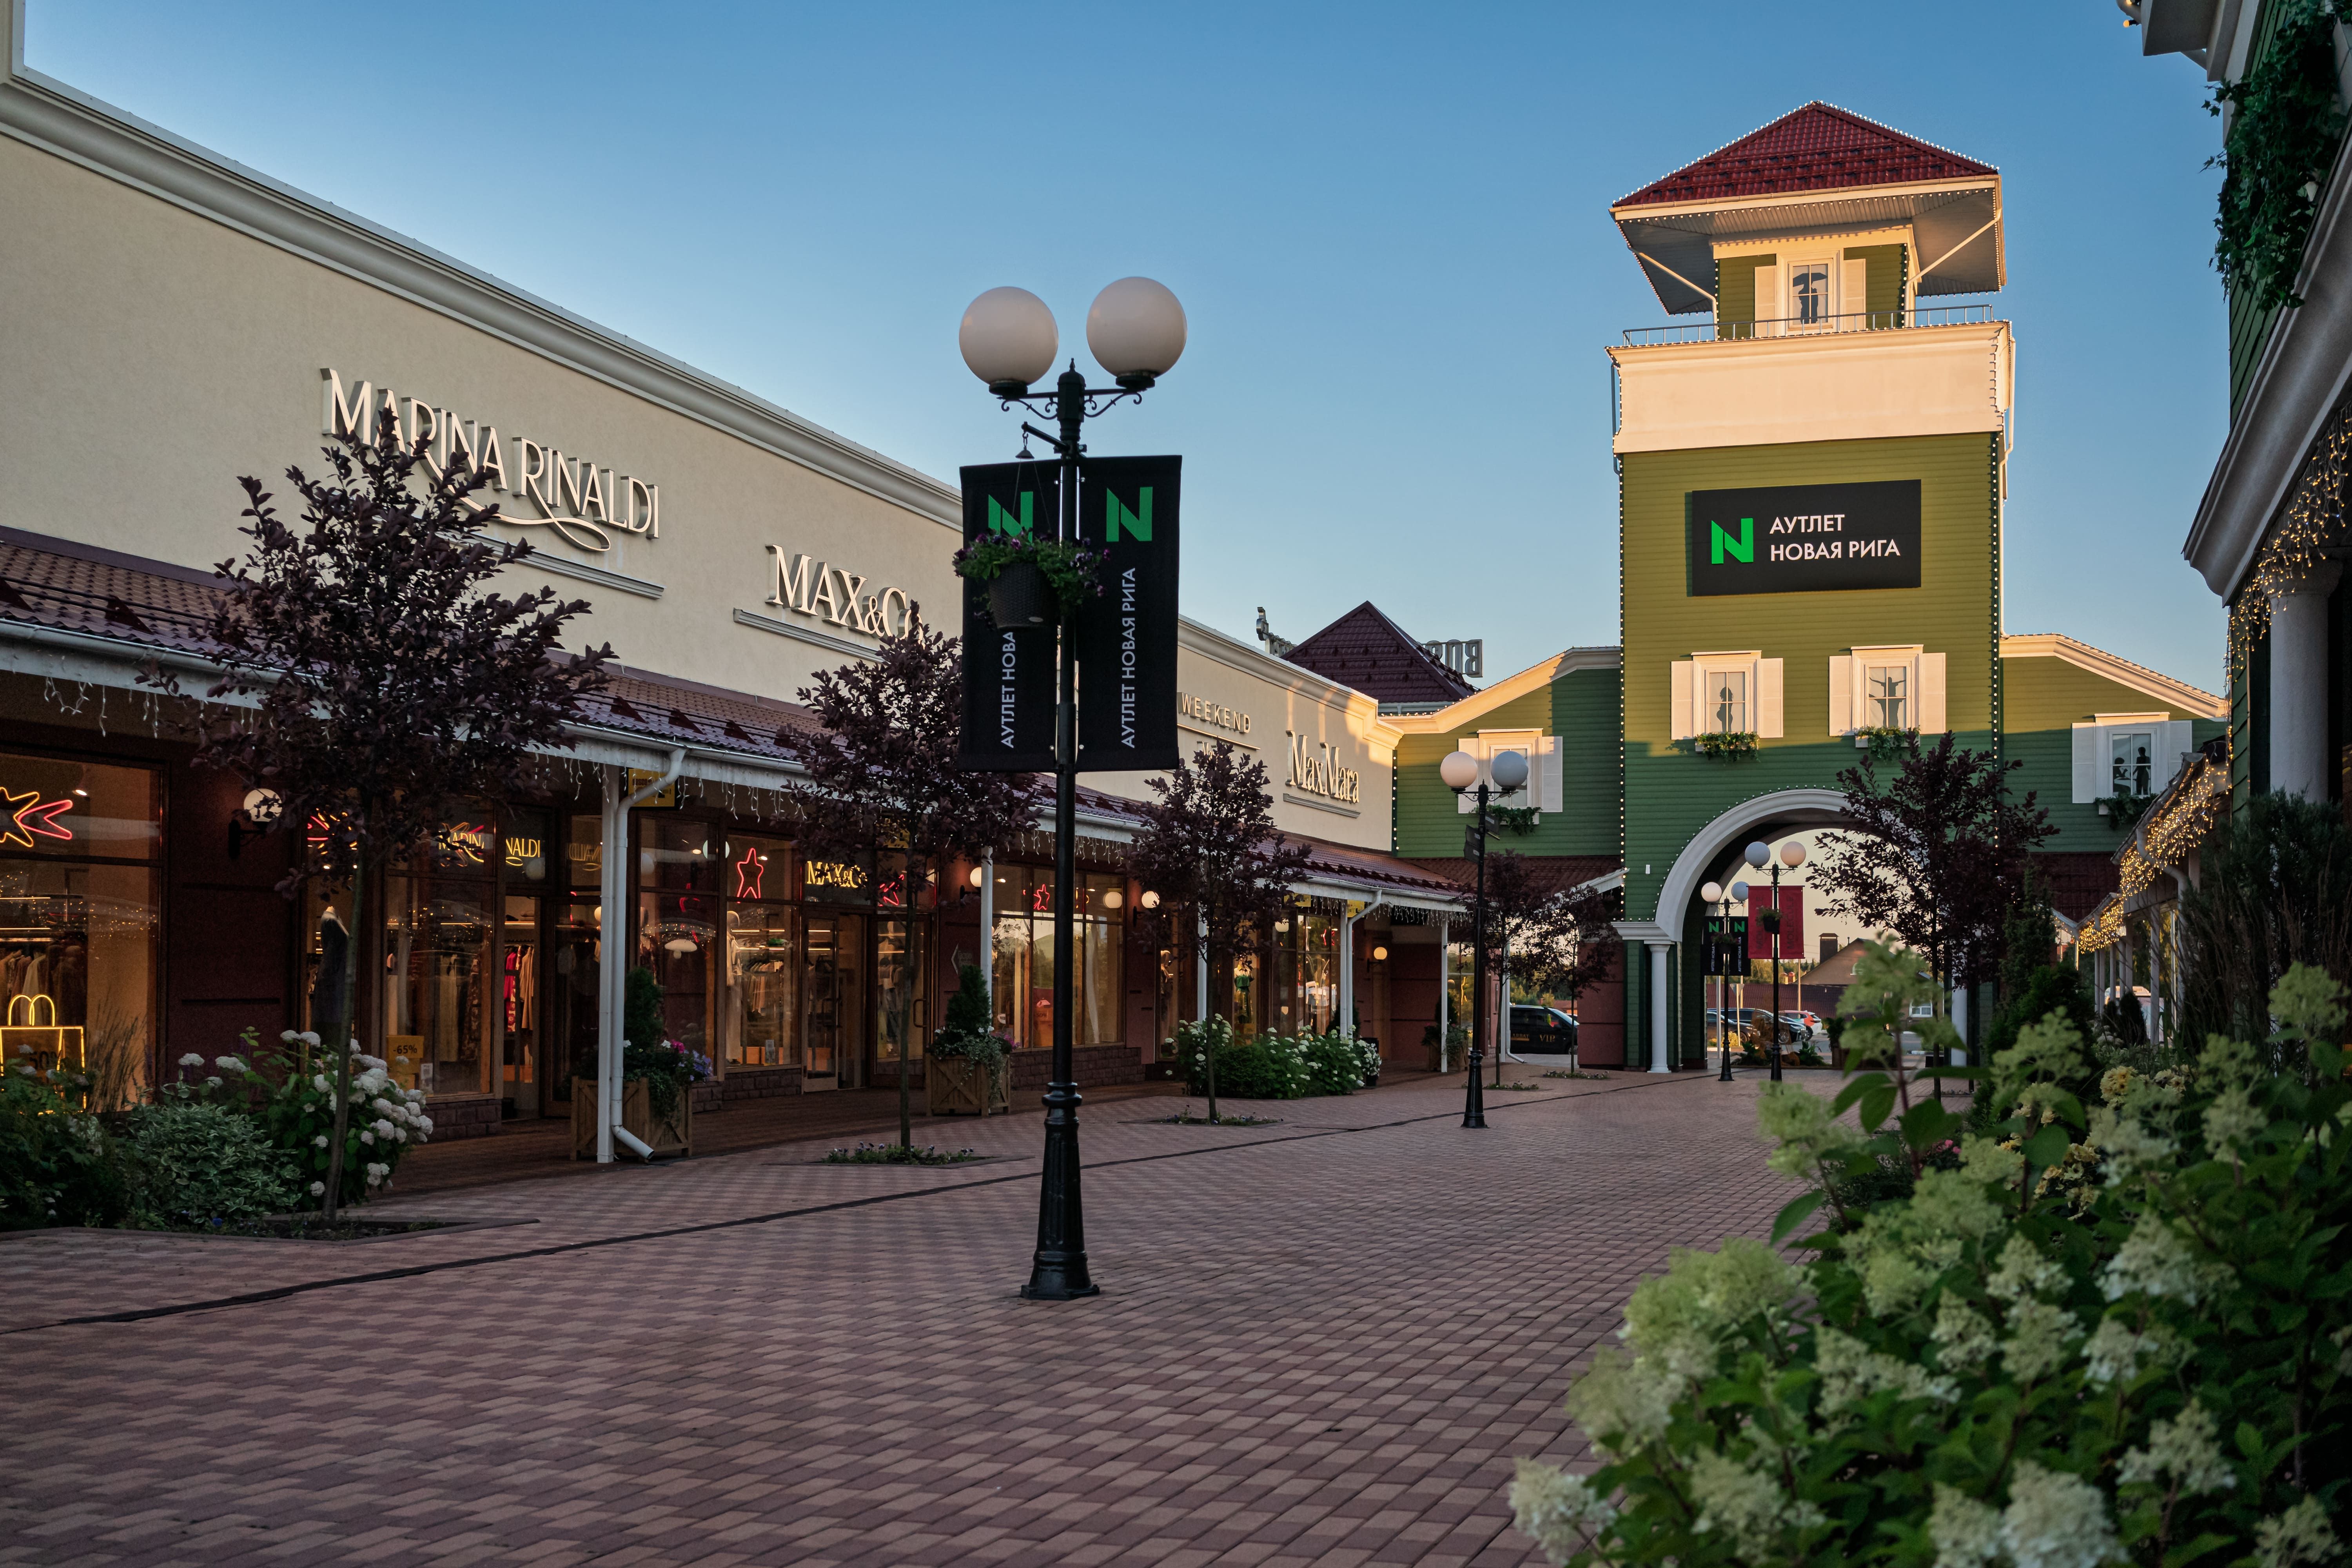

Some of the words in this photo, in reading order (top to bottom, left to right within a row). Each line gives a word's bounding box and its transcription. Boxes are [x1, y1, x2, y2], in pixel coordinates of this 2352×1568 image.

[512, 437, 659, 551] RINALDI
[1769, 514, 1845, 534] АУТЛЕТ
[1770, 542, 1842, 561] НОВАЯ
[1849, 539, 1900, 558] РИГА
[1122, 568, 1136, 611] РИГА
[1002, 632, 1016, 680] НОВА
[1122, 618, 1135, 679] НОВАЯ
[1001, 684, 1016, 749] АУТЛЕТ
[1121, 684, 1135, 749] АУТЛЕТ
[1178, 692, 1250, 733] WEEKEND
[1286, 730, 1359, 804] MaxMara
[393, 1044, 417, 1054] -65%
